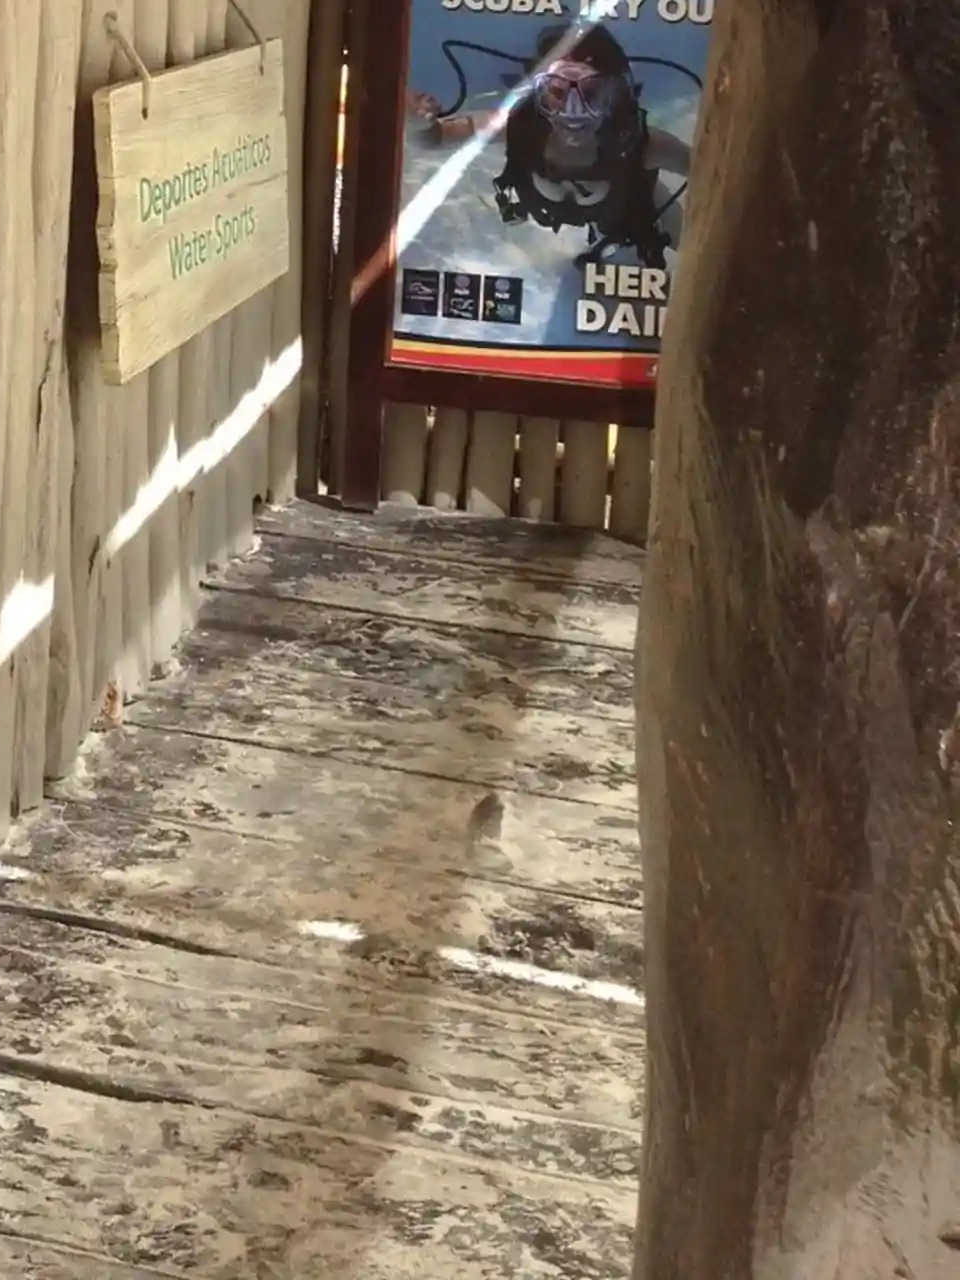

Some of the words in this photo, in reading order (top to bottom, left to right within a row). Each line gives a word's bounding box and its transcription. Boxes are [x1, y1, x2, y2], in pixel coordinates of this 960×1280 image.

[139, 162, 209, 225] Deportes
[168, 228, 212, 280] Water
[214, 203, 256, 261] Sports
[584, 262, 669, 300] HER
[576, 299, 664, 338] DAI
